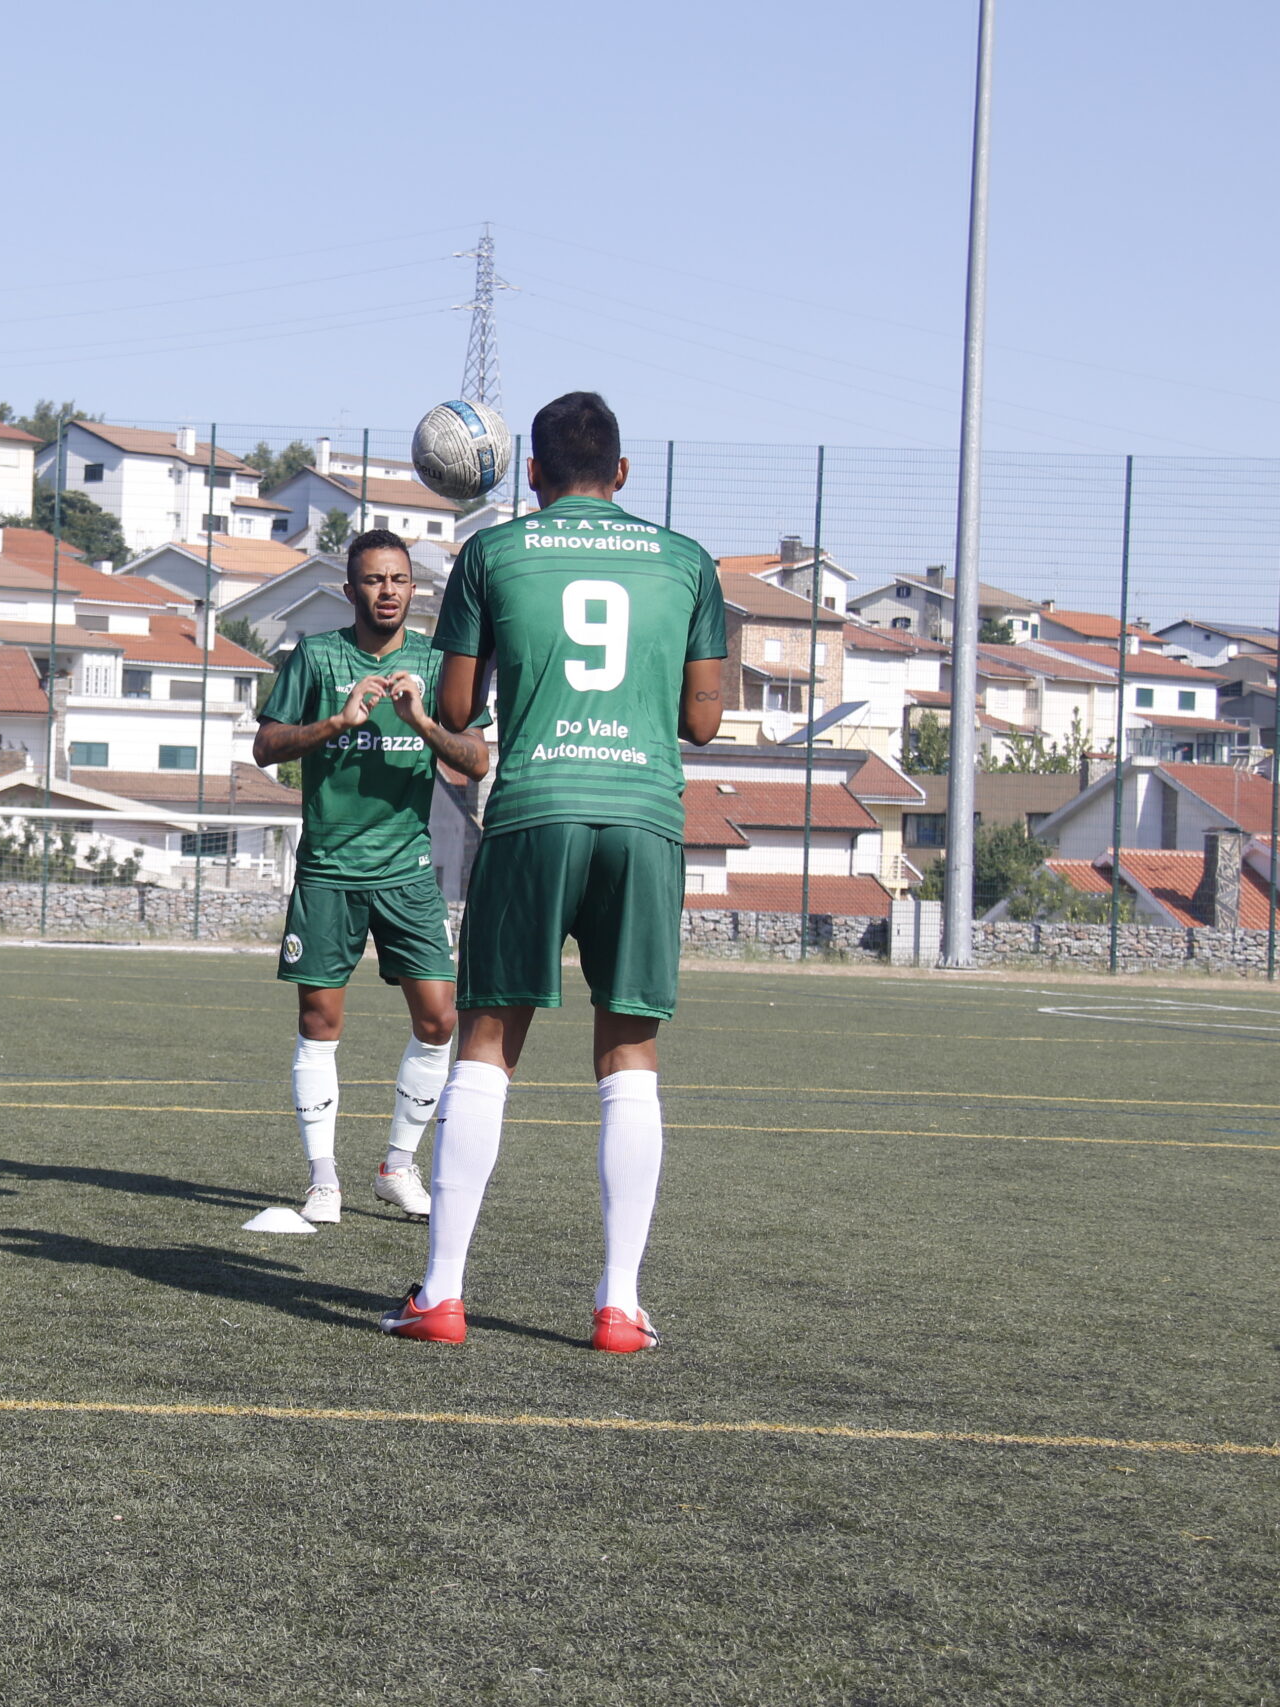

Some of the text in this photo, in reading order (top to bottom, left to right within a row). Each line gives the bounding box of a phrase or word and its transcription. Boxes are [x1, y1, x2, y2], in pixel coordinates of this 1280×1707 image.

[525, 519, 658, 534] S. T. A Tome
[524, 533, 661, 553] Renovations
[562, 579, 630, 692] 9
[556, 718, 628, 738] Do Vale
[357, 731, 425, 751] Brazza
[531, 743, 648, 765] Automoveis
